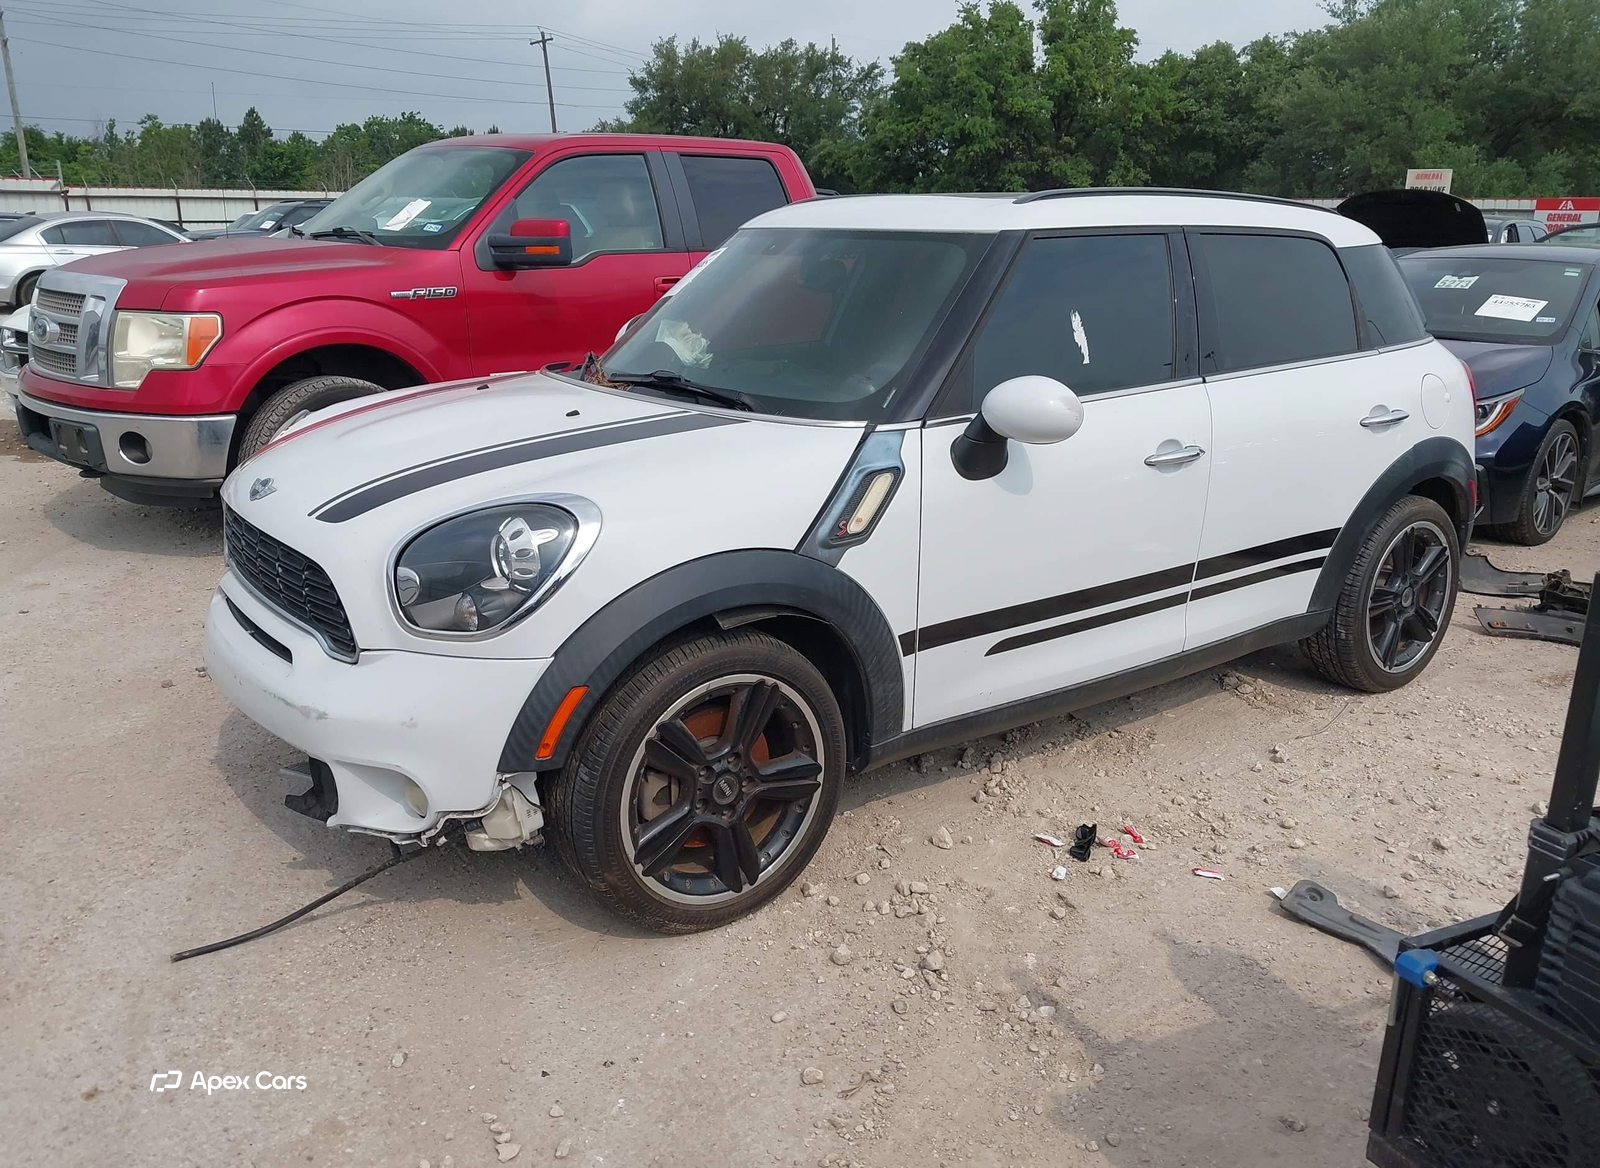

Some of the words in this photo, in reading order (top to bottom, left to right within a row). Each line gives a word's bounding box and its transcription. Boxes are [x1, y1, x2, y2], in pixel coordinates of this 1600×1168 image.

[1546, 213, 1582, 222] GENERAL
[1437, 279, 1472, 288] 5273
[409, 286, 458, 300] F-150
[836, 520, 848, 537] S
[719, 779, 733, 797] MINI
